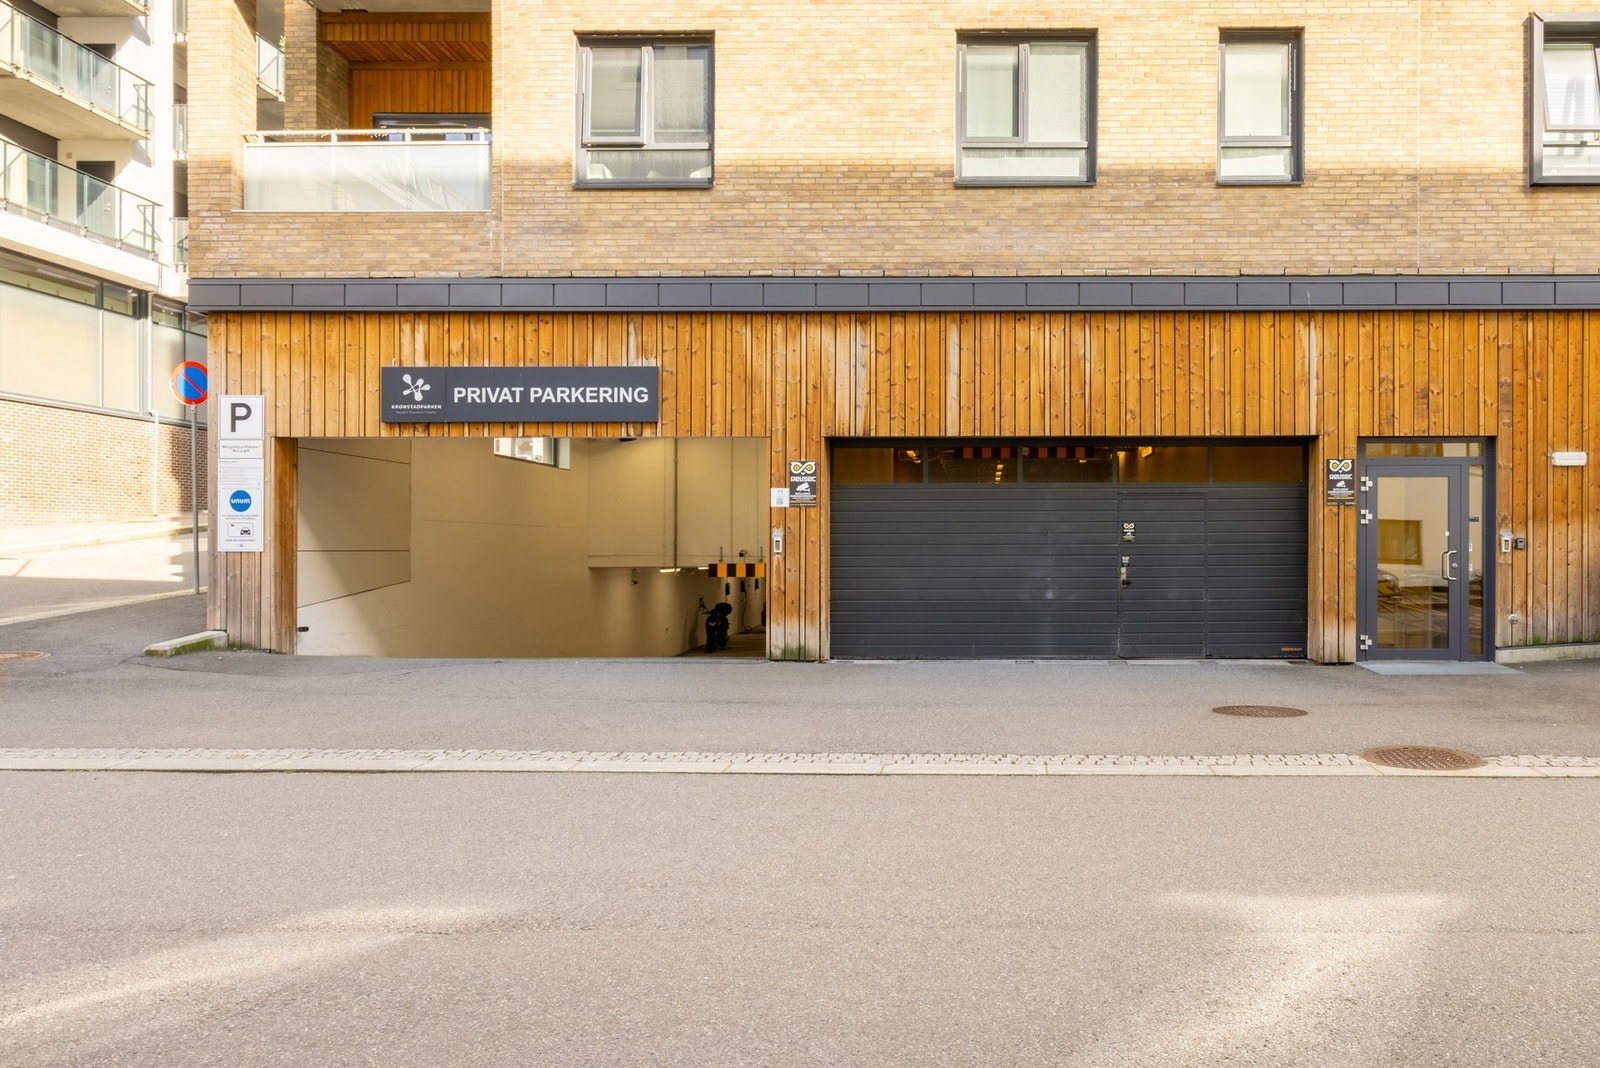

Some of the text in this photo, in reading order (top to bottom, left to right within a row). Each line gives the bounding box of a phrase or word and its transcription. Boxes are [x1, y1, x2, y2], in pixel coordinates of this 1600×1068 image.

[453, 386, 649, 404] PRIVAT PARKERING
[230, 402, 252, 432] P
